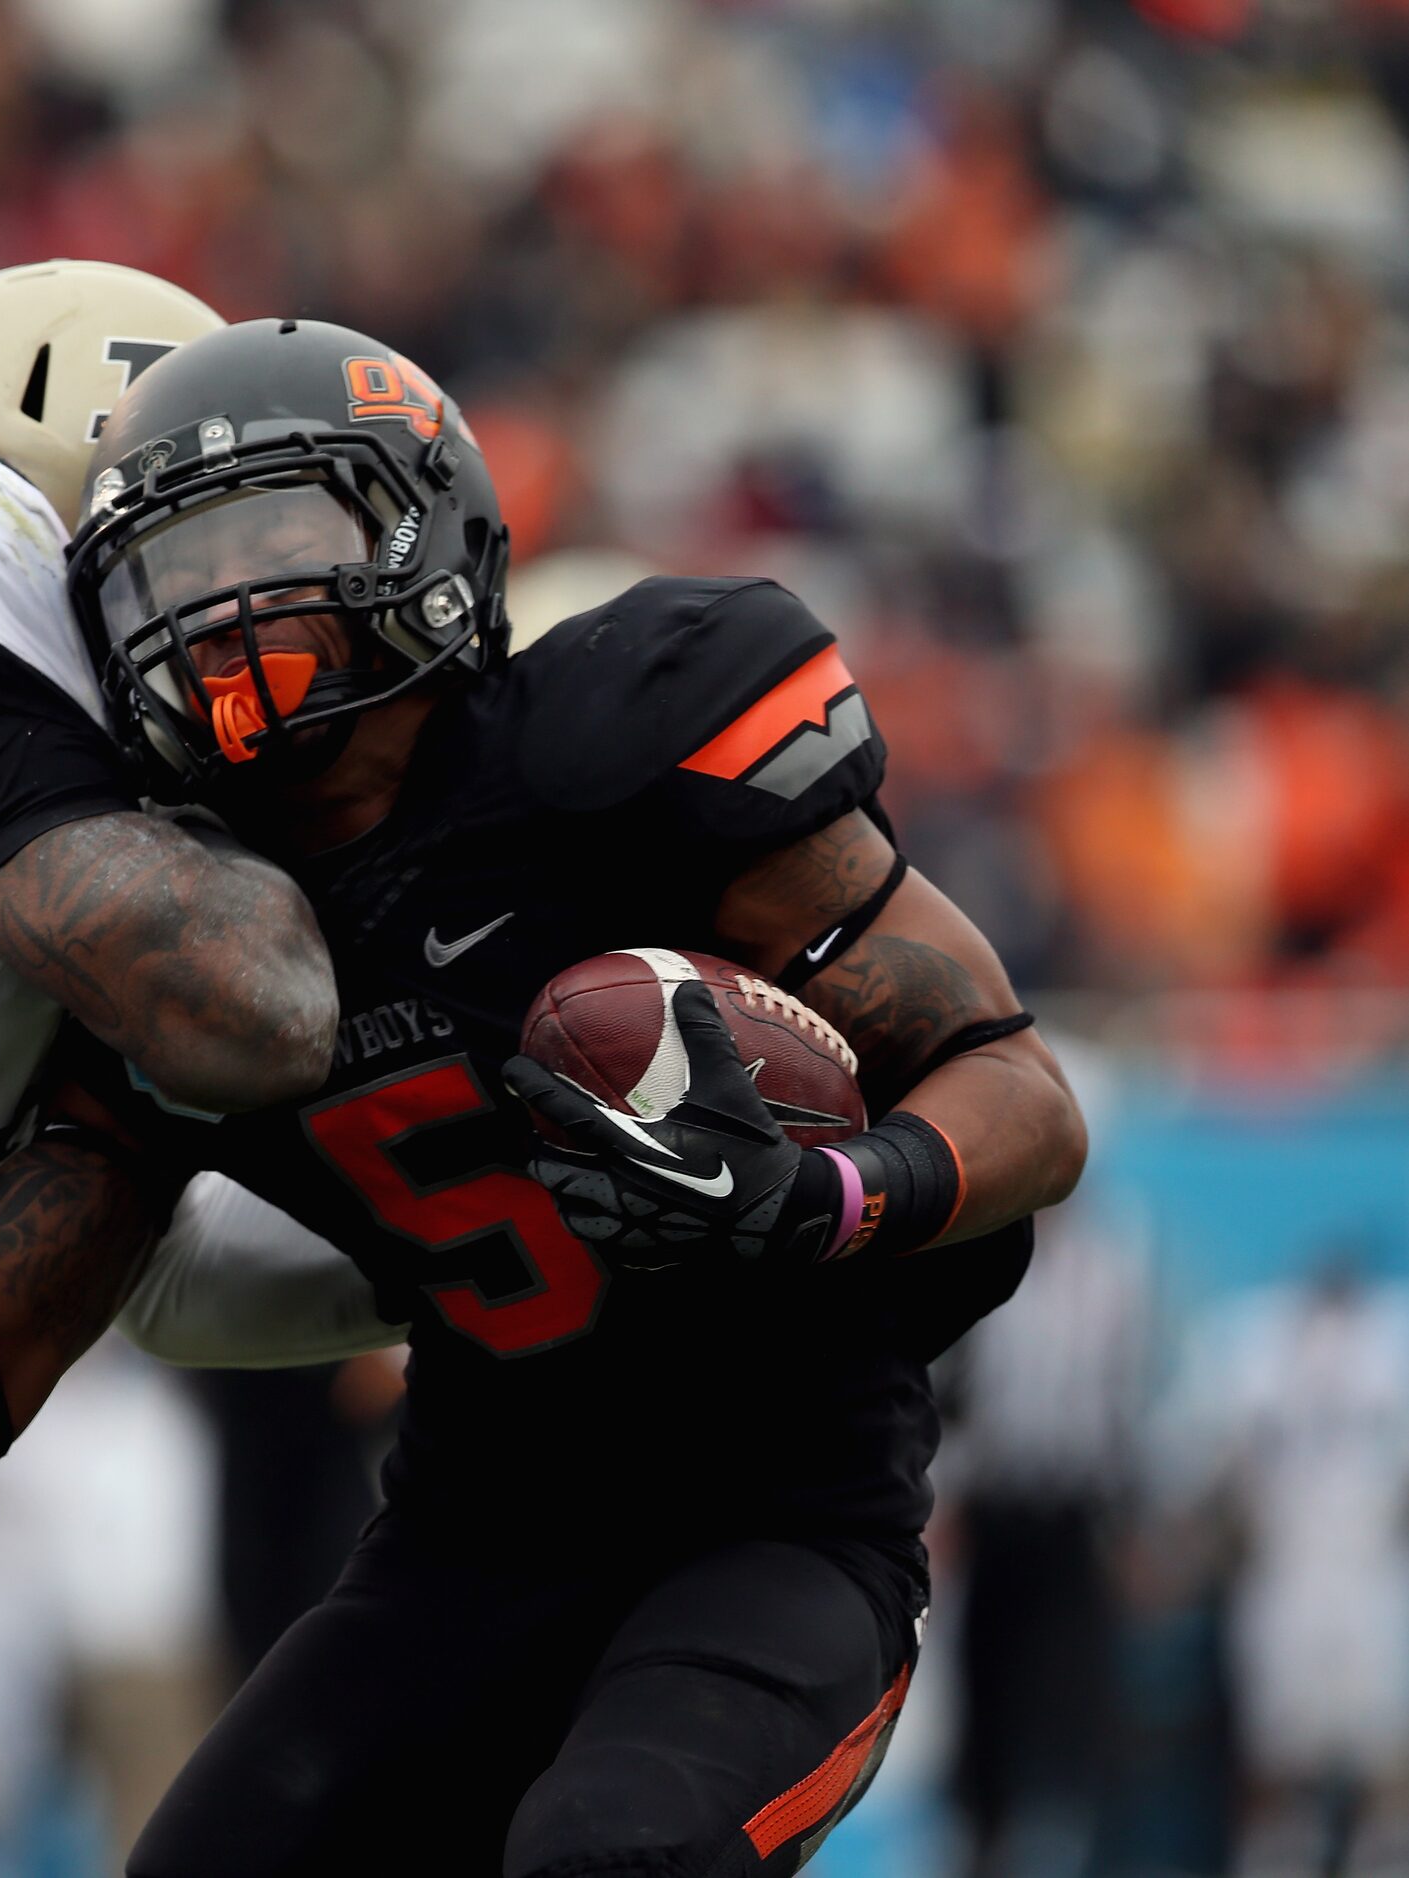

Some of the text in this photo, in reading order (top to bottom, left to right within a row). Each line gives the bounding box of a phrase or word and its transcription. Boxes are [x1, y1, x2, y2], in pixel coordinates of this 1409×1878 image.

[388, 505, 421, 569] WBOYS
[333, 998, 455, 1071] WBOYS
[299, 1052, 610, 1360] 5
